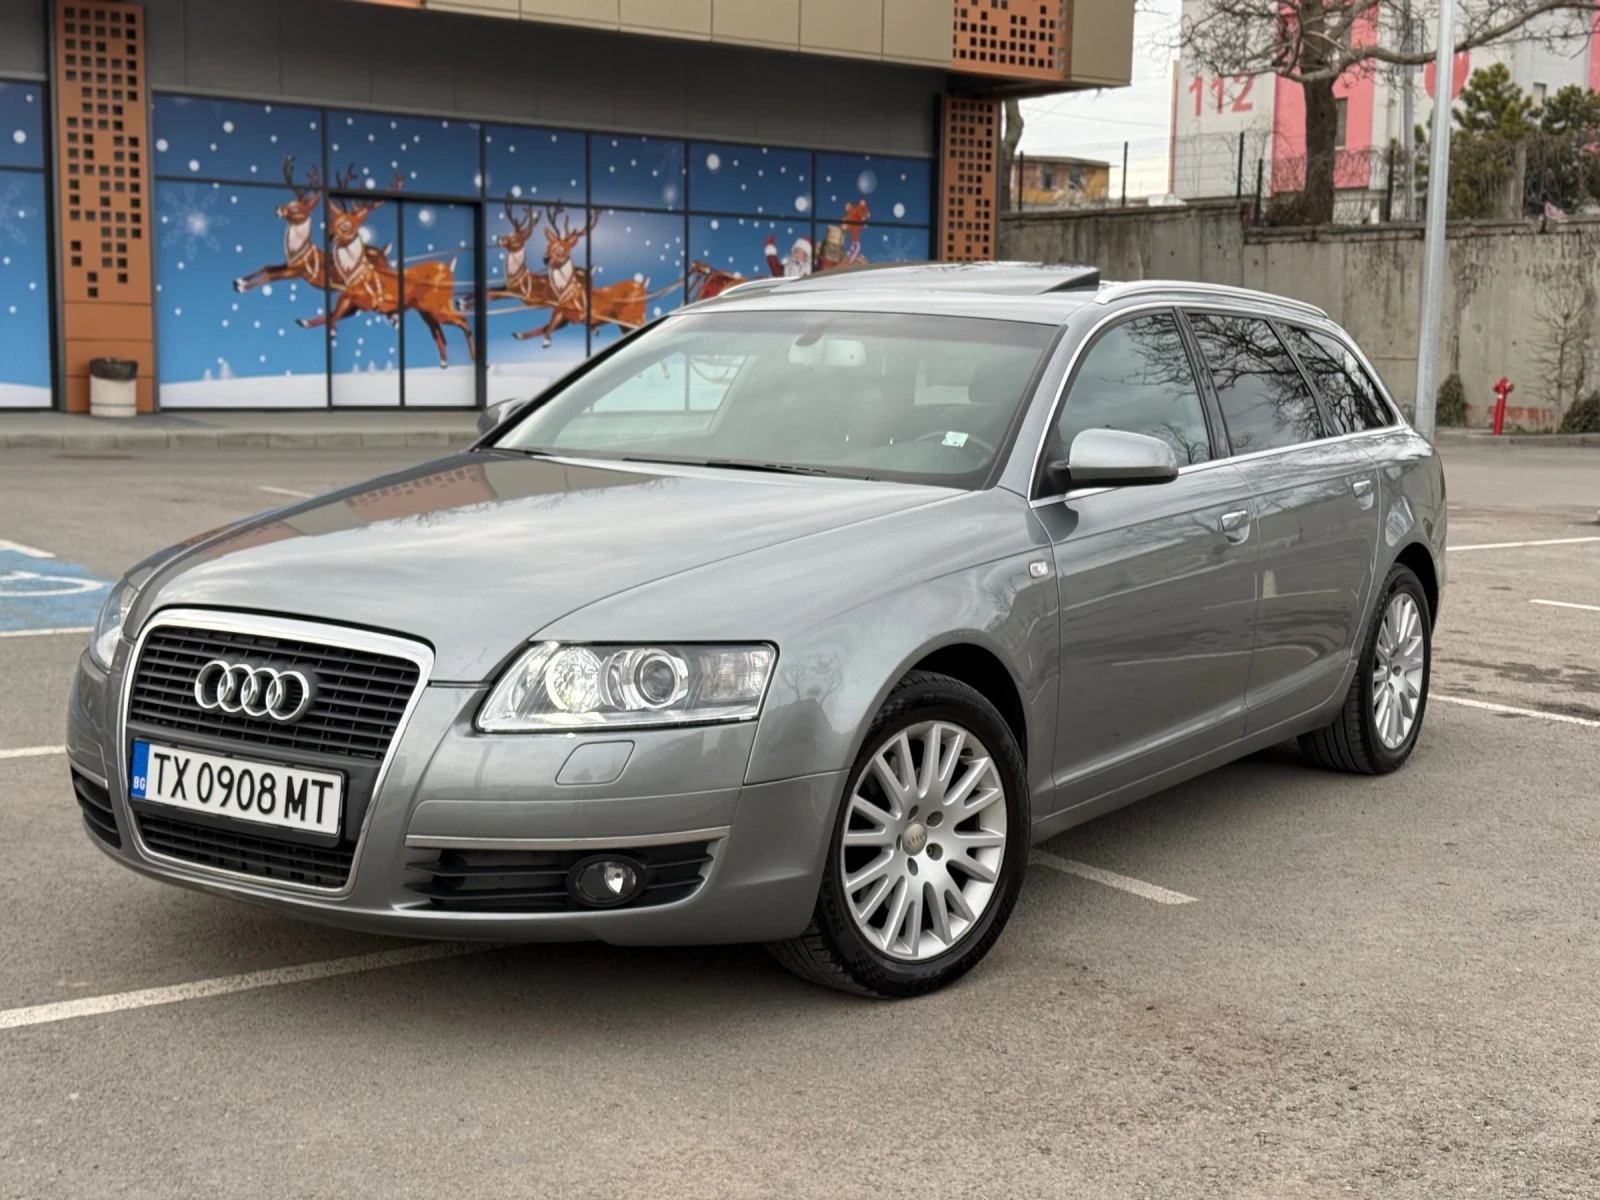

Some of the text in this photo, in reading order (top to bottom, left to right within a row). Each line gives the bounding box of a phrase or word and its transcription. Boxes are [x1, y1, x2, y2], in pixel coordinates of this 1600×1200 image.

[1189, 69, 1253, 117] 112
[133, 775, 146, 790] BG
[153, 752, 333, 825] TX 0908 MT
